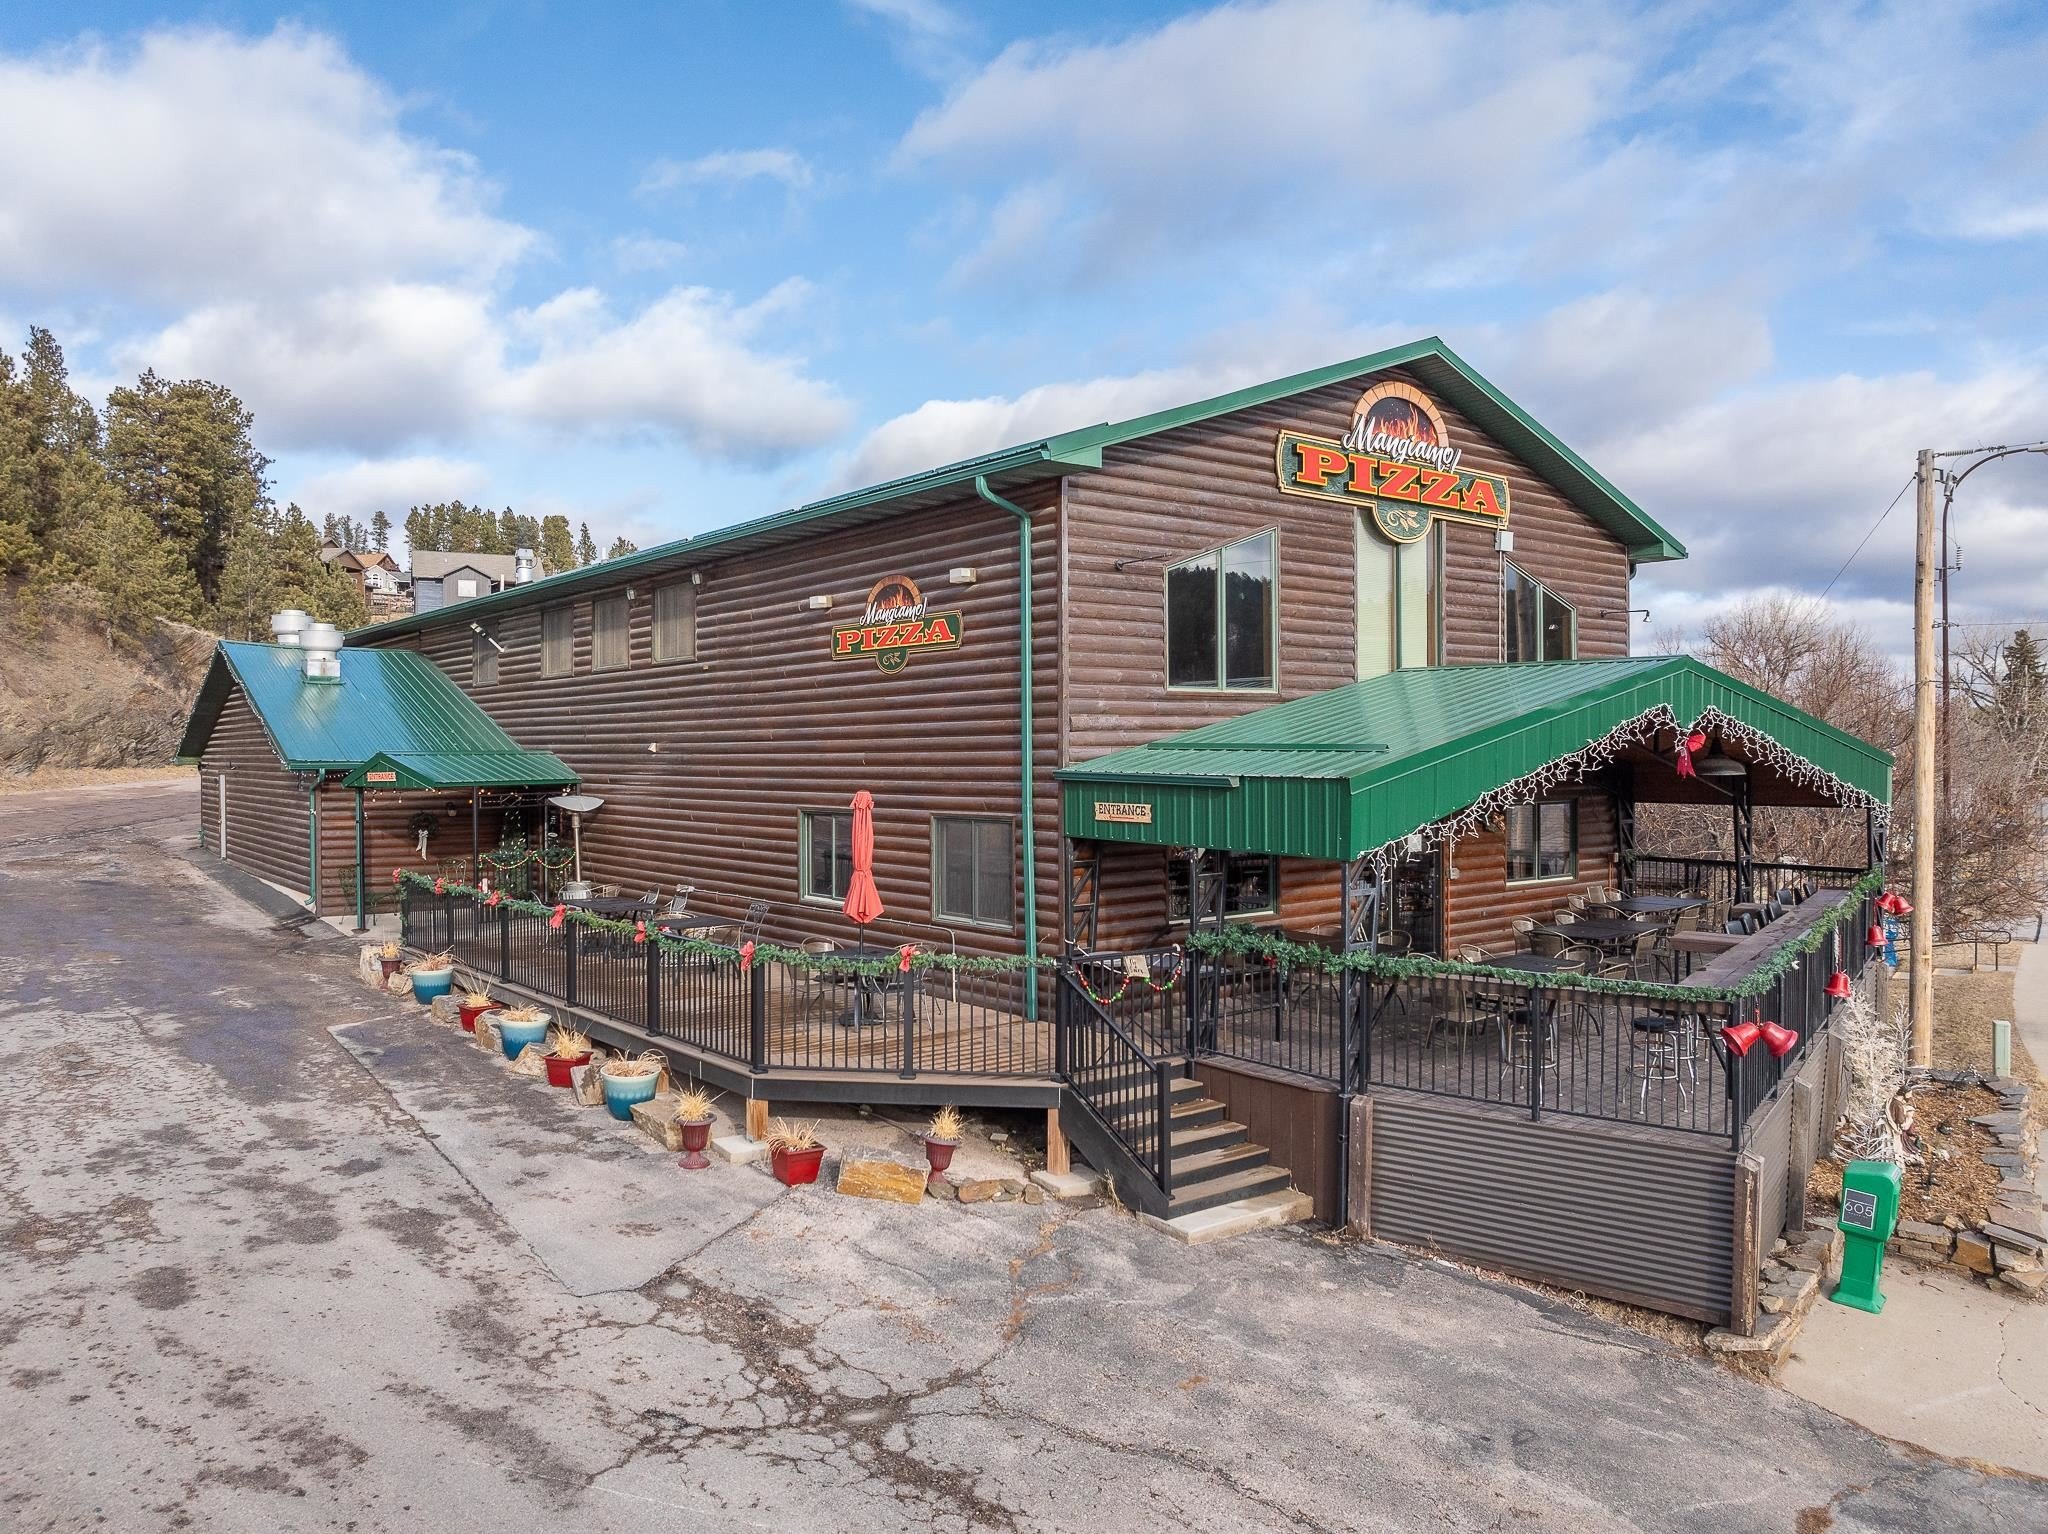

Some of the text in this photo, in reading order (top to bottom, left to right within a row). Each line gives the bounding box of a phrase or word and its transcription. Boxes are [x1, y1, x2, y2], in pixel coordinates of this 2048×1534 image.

[1342, 414, 1462, 473] Mangiamo!
[1296, 442, 1505, 518] PIZZA
[859, 596, 928, 626] Mangiamo!
[836, 618, 956, 654] PIZZA
[1098, 803, 1147, 817] ENTRANCE
[1844, 1201, 1874, 1217] 605
